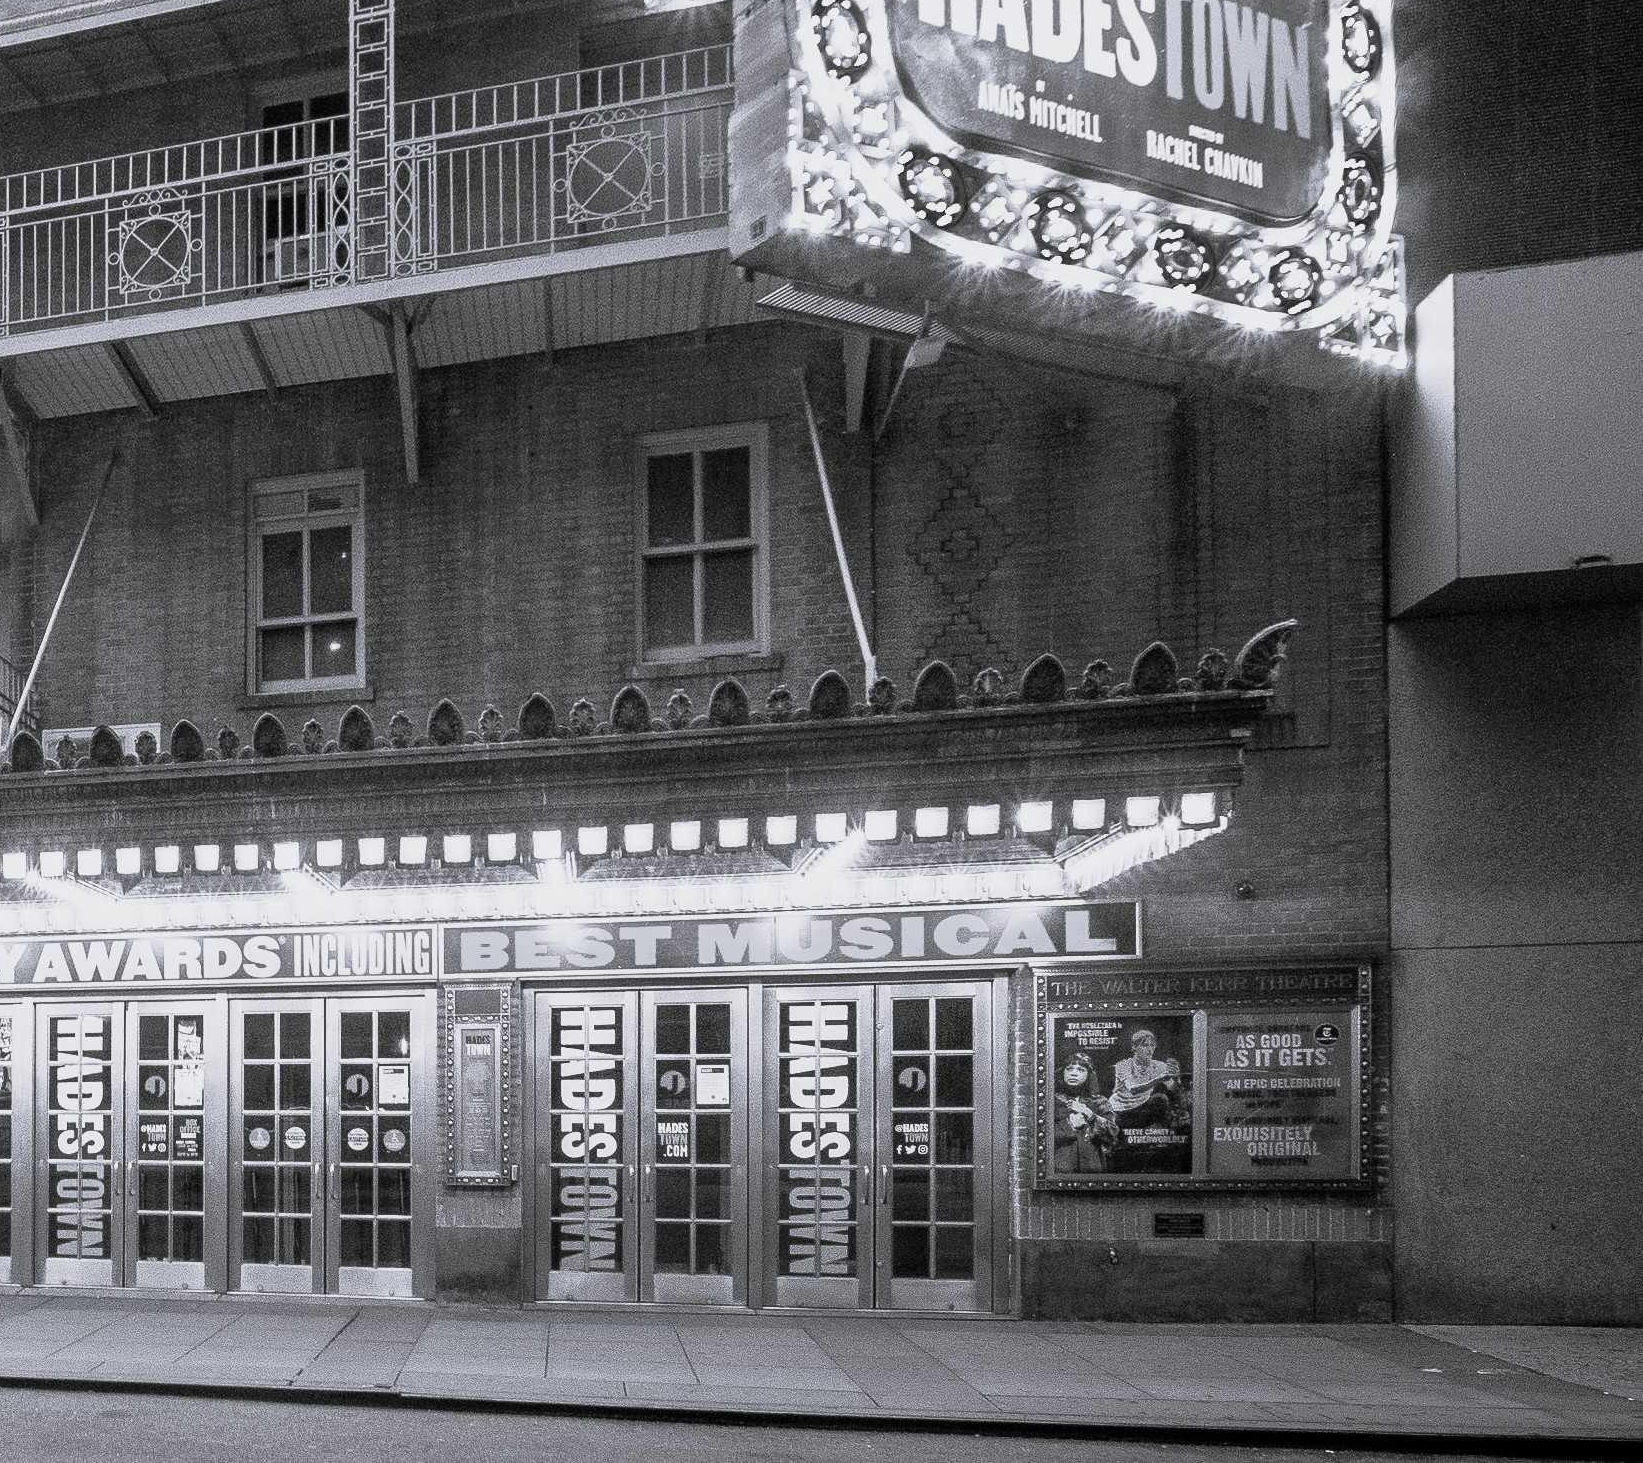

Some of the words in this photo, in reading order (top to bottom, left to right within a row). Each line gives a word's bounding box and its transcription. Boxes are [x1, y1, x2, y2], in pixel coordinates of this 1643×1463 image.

[1029, 95, 1103, 143] MITCHELL
[1146, 129, 1201, 171] RACHEL
[1204, 147, 1263, 189] CHAVKIN
[460, 923, 673, 971] BEST
[697, 910, 1118, 965] MUSICAL
[293, 931, 432, 978] INCLUDING
[1051, 981, 1092, 997] THE
[1102, 980, 1178, 995] WALTER
[1189, 978, 1246, 993] KERR
[1259, 975, 1354, 990] THEATRE
[1064, 1030, 1109, 1038] IMPOSSIBLE
[1235, 1034, 1256, 1049] AS
[1260, 1034, 1302, 1048] GOOD
[1223, 1049, 1250, 1068] AS
[1255, 1048, 1274, 1067] IT
[1243, 1078, 1268, 1089] EPIC
[1270, 1077, 1341, 1089] CELEBRATION
[657, 1122, 689, 1134] HADES
[894, 1123, 929, 1133] @HADES
[1213, 1126, 1313, 1142] EXQUISITELY
[57, 1016, 105, 1257] HADESTOWN
[560, 1009, 618, 1271] HADESTOWN
[658, 1133, 689, 1146] TOWN
[789, 1004, 851, 1274] HADESTOWN
[904, 1132, 929, 1143] TOWN
[662, 1144, 689, 1158] .COM
[1246, 1141, 1322, 1157] ORIGINAL
